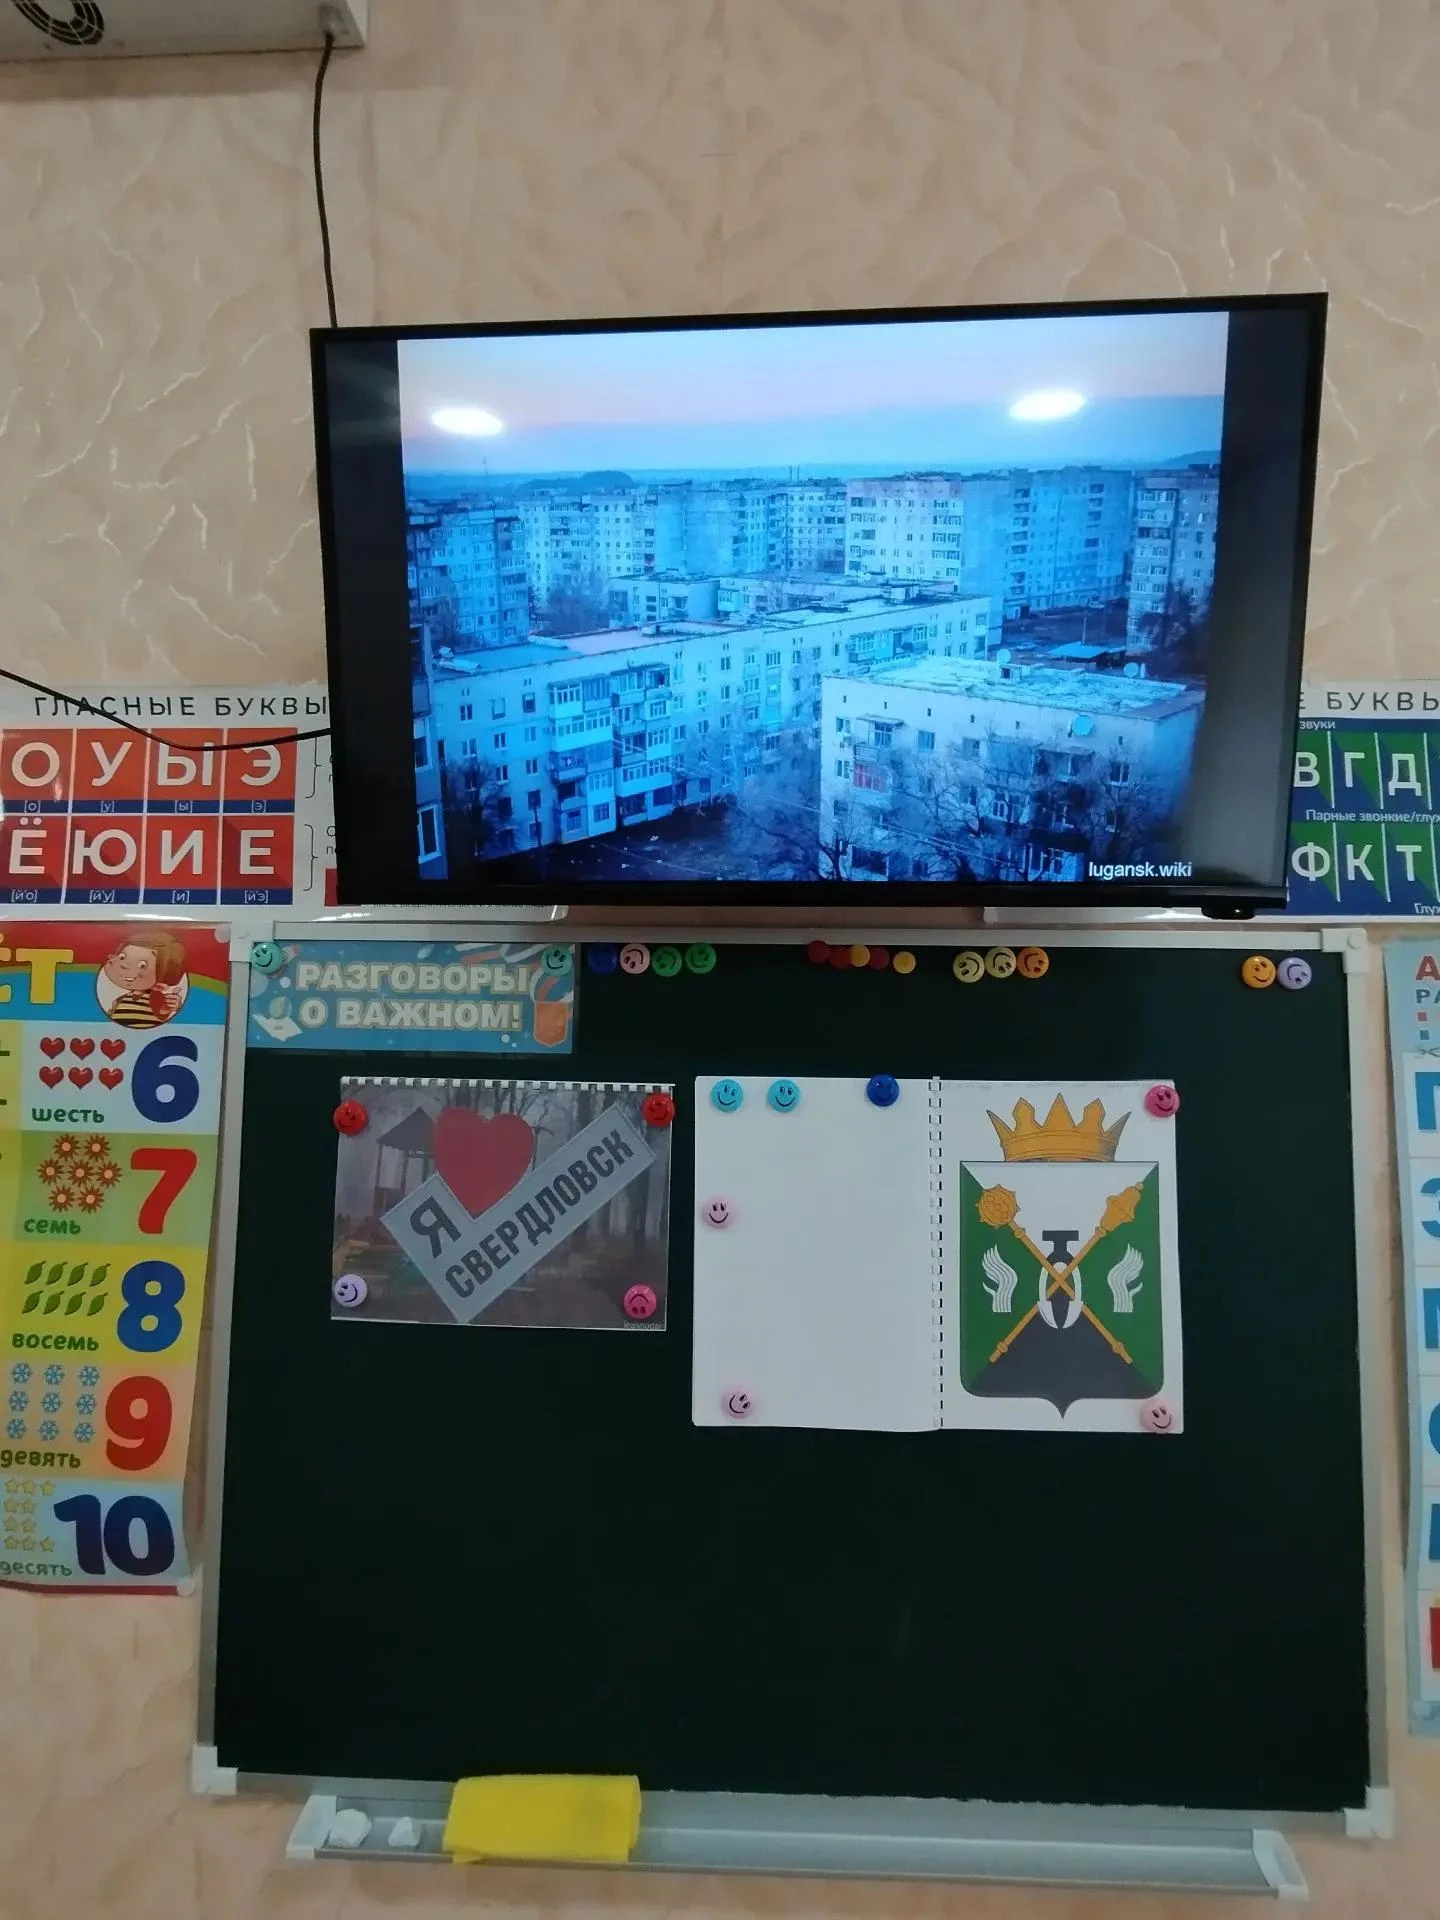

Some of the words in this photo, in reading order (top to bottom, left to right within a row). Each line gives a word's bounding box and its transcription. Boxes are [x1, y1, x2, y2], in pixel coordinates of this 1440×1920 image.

[34, 696, 195, 716] ГЛАСНЫЕ
[215, 696, 327, 716] БУКВЫ
[1299, 719, 1336, 731] звуки
[12, 742, 60, 787] О
[91, 741, 132, 787] У
[157, 742, 214, 786] Ы
[240, 742, 282, 787] Э
[1344, 752, 1365, 788] Г
[1388, 753, 1422, 796] Д
[1305, 809, 1356, 823] Парные
[8, 816, 47, 875] Ё
[72, 828, 137, 876] Ю
[161, 829, 204, 875] И
[1291, 842, 1331, 881] Ф
[1088, 861, 1193, 881] lugansk.wiki
[295, 962, 530, 994] РАЗГОВОРЫ
[300, 999, 328, 1028] О
[336, 1000, 523, 1031] ВАЖНОМ!
[131, 1035, 200, 1123] 6
[31, 1107, 105, 1123] шесть
[130, 1147, 198, 1235] 7
[24, 1217, 82, 1235] семь
[410, 1196, 462, 1259] Я
[445, 1128, 634, 1299] СВЕРДЛОВСК
[116, 1260, 186, 1353] 8
[12, 1331, 99, 1351] восемь
[105, 1375, 173, 1472] 9
[0, 1449, 82, 1469] девять
[53, 1493, 175, 1577] 10
[0, 1560, 73, 1577] десять
